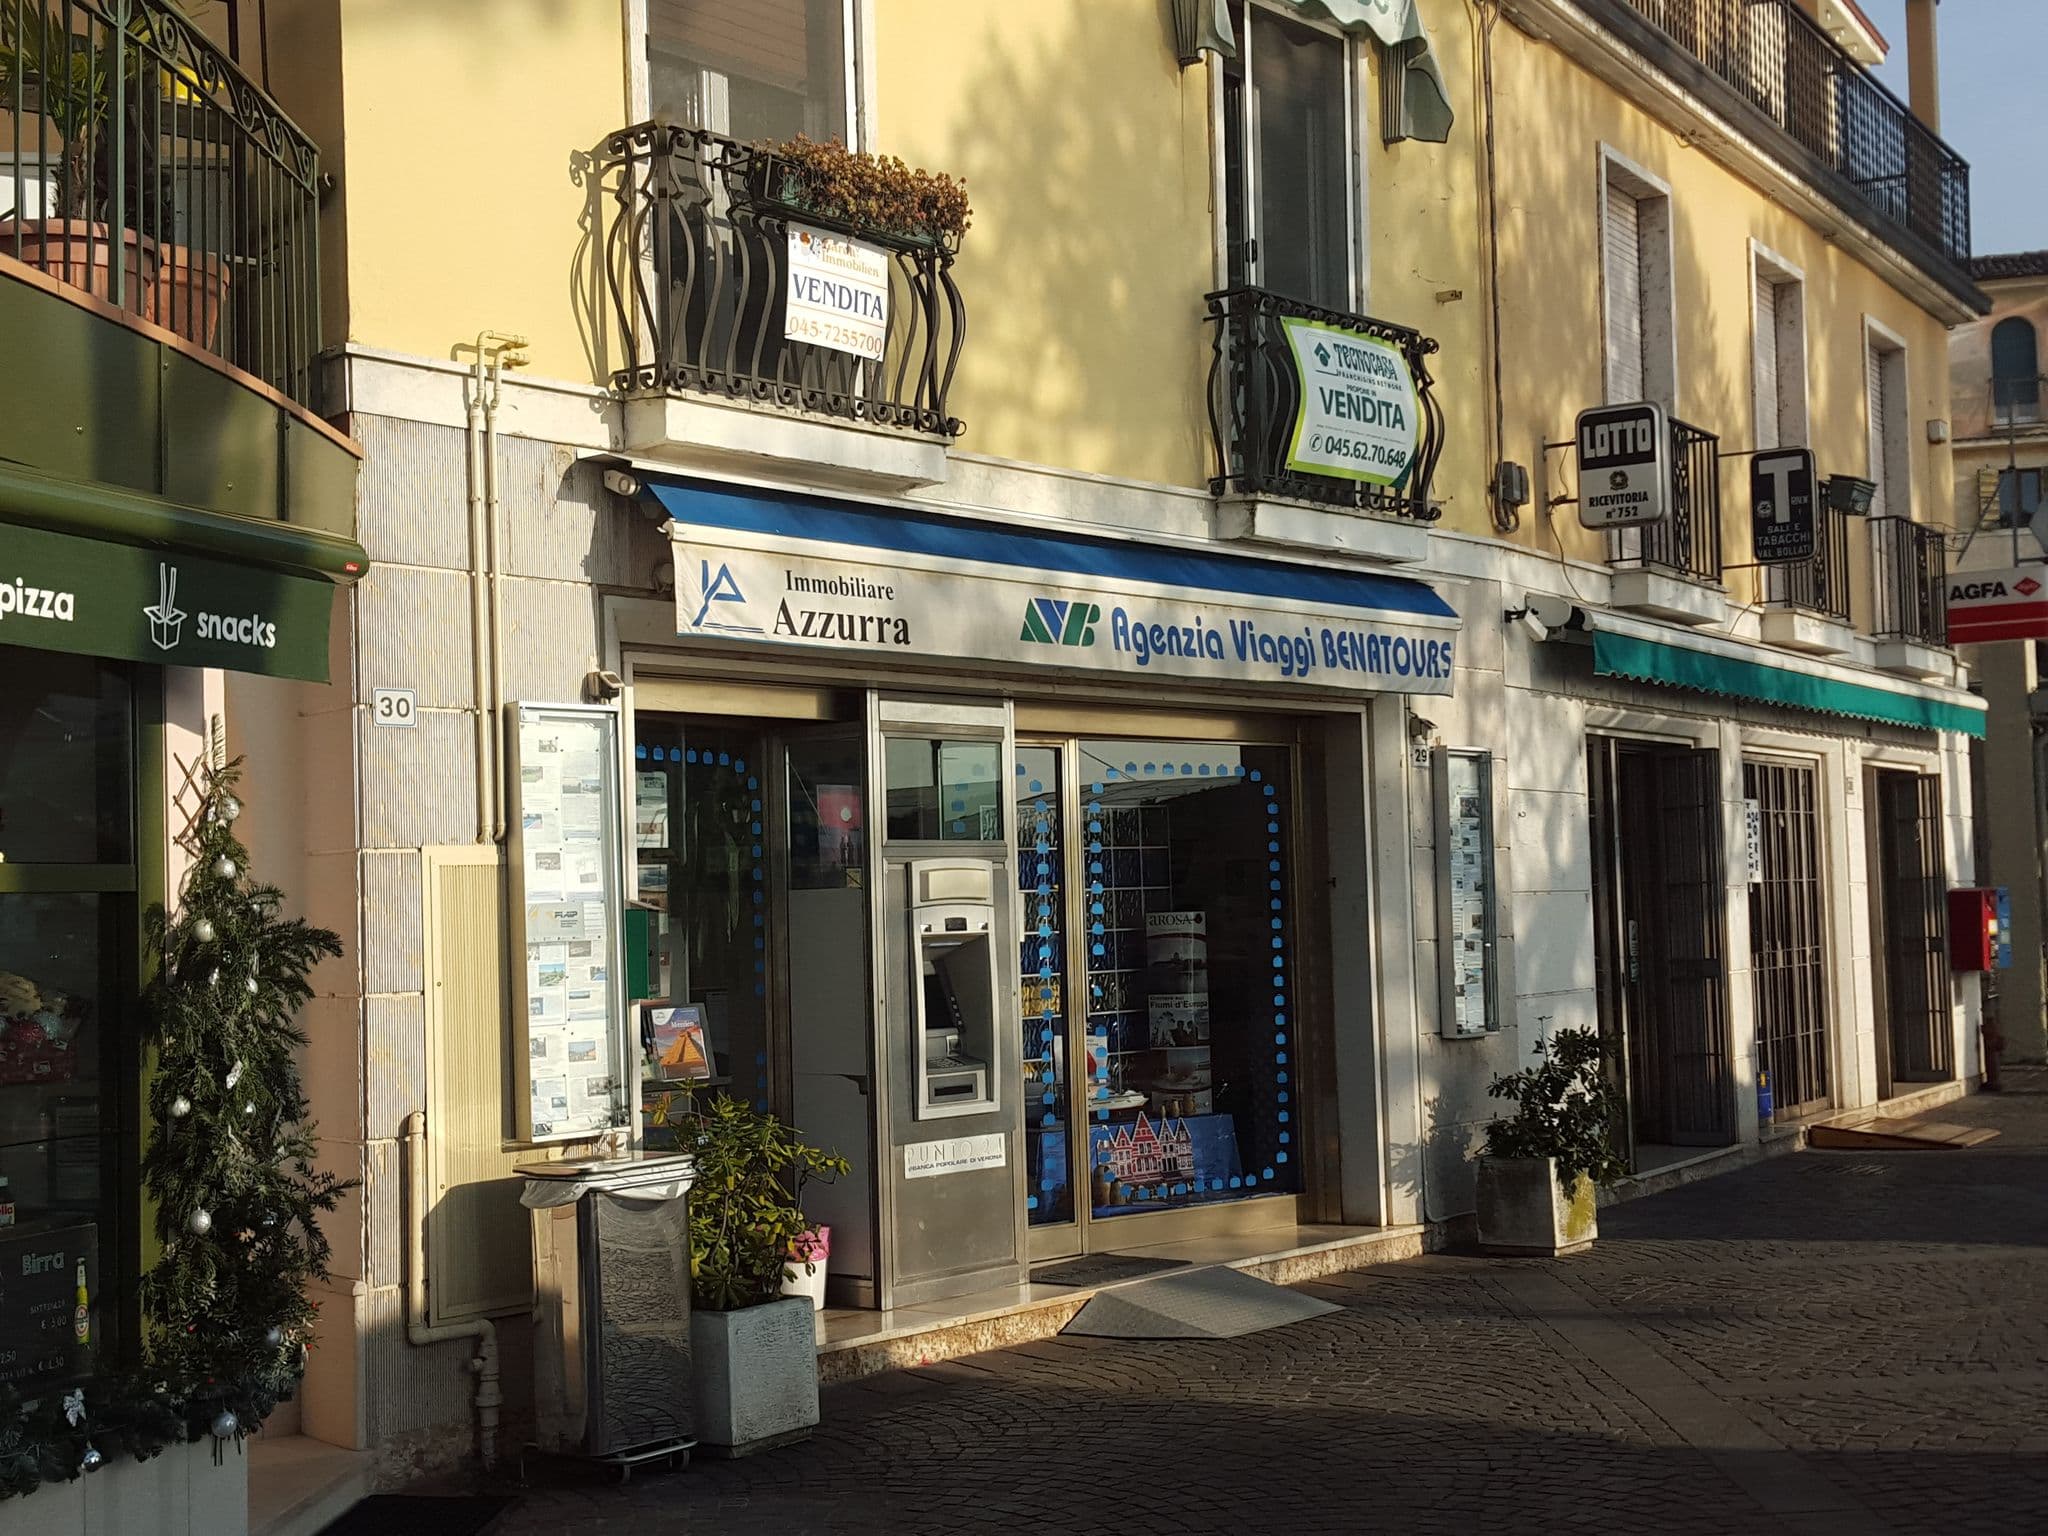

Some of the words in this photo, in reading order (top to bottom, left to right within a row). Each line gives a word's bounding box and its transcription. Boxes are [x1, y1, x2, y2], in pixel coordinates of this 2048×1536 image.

[793, 273, 883, 321] VENDITA
[1319, 386, 1405, 431] VENDITA
[1325, 435, 1407, 469] 045.62.70.648
[1582, 418, 1652, 459] LOTTO
[1588, 491, 1649, 508] RICEVITORIA
[1758, 455, 1804, 524] T
[1617, 506, 1639, 518] 752
[1758, 530, 1810, 547] TABACCHI
[0, 577, 75, 621] pizza
[784, 569, 895, 601] Immobiliare
[1950, 581, 2009, 601] AGFA
[197, 611, 277, 649] snacks
[773, 597, 911, 645] Azzurra
[1111, 606, 1225, 665] Agenzia
[1229, 619, 1314, 678] Viaggi
[1320, 628, 1452, 679] BENATOURS
[380, 696, 411, 718] 30
[1414, 748, 1428, 763] 29
[22, 1252, 65, 1276] Birra
